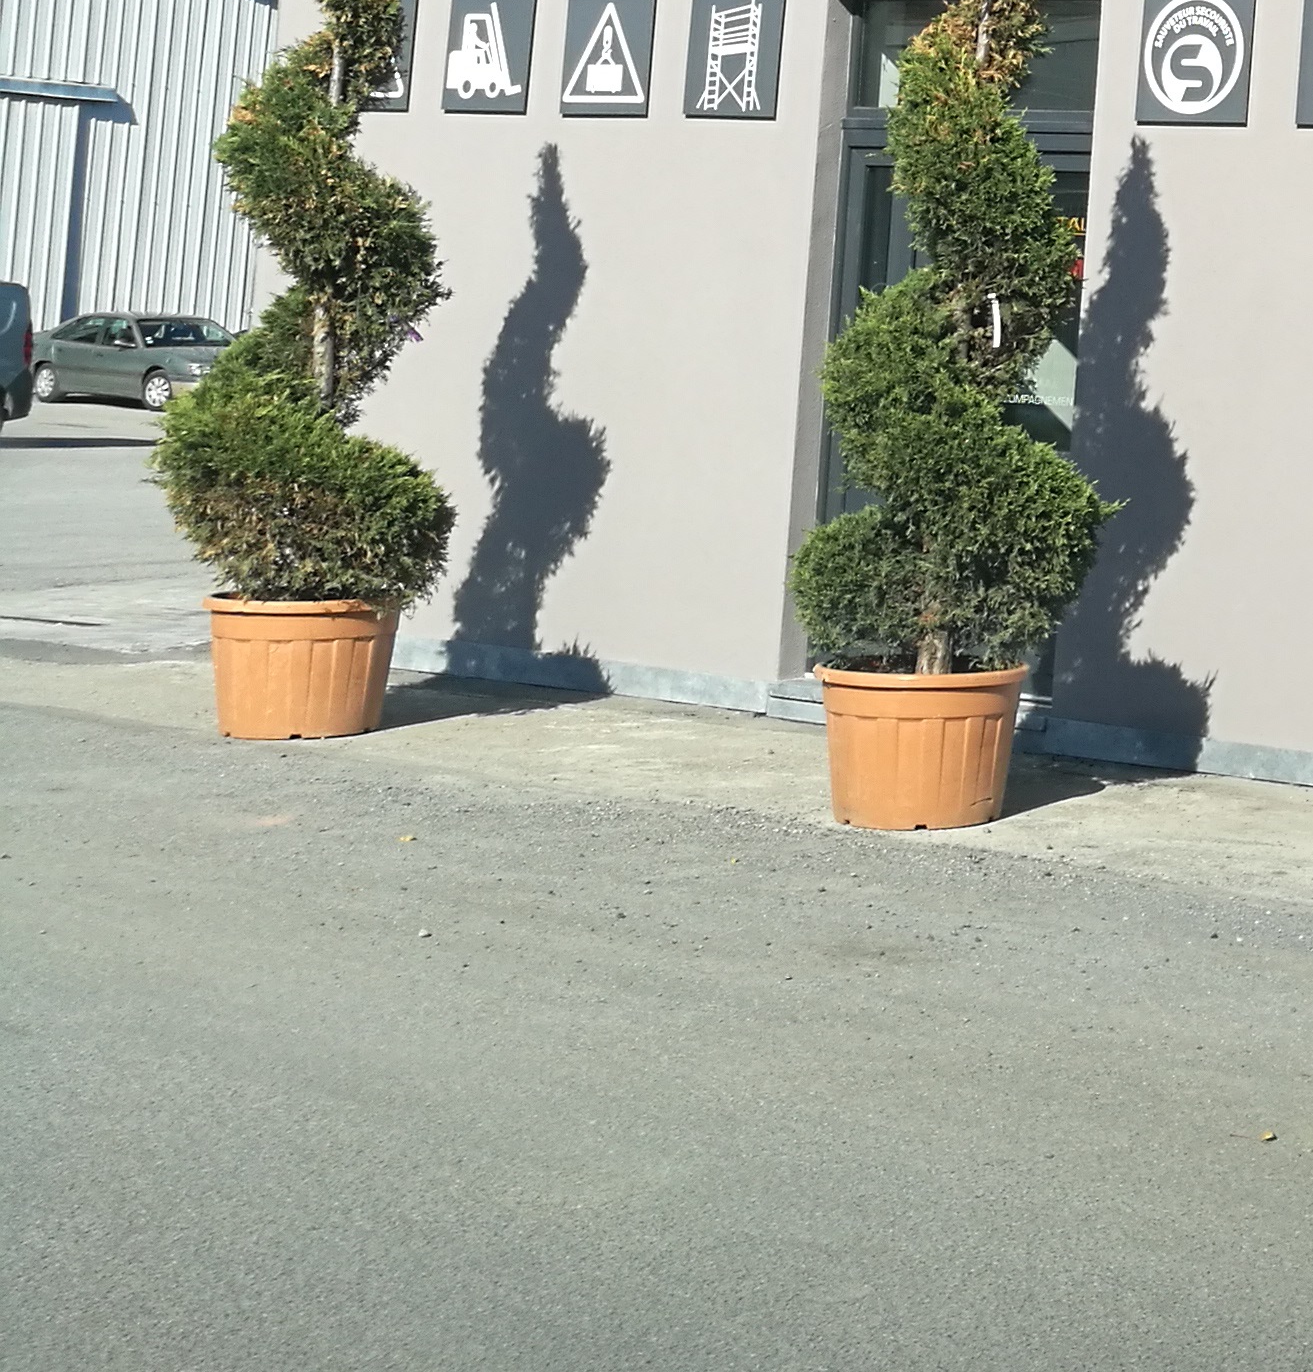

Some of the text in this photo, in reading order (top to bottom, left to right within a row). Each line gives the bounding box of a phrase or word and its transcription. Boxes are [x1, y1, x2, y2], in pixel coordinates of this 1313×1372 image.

[1154, 6, 1235, 48] SAUVETEUR SECOURISTE
[1173, 16, 1219, 37] DU TRAVAIL
[1004, 394, 1074, 406] OMPAGNEMEN
